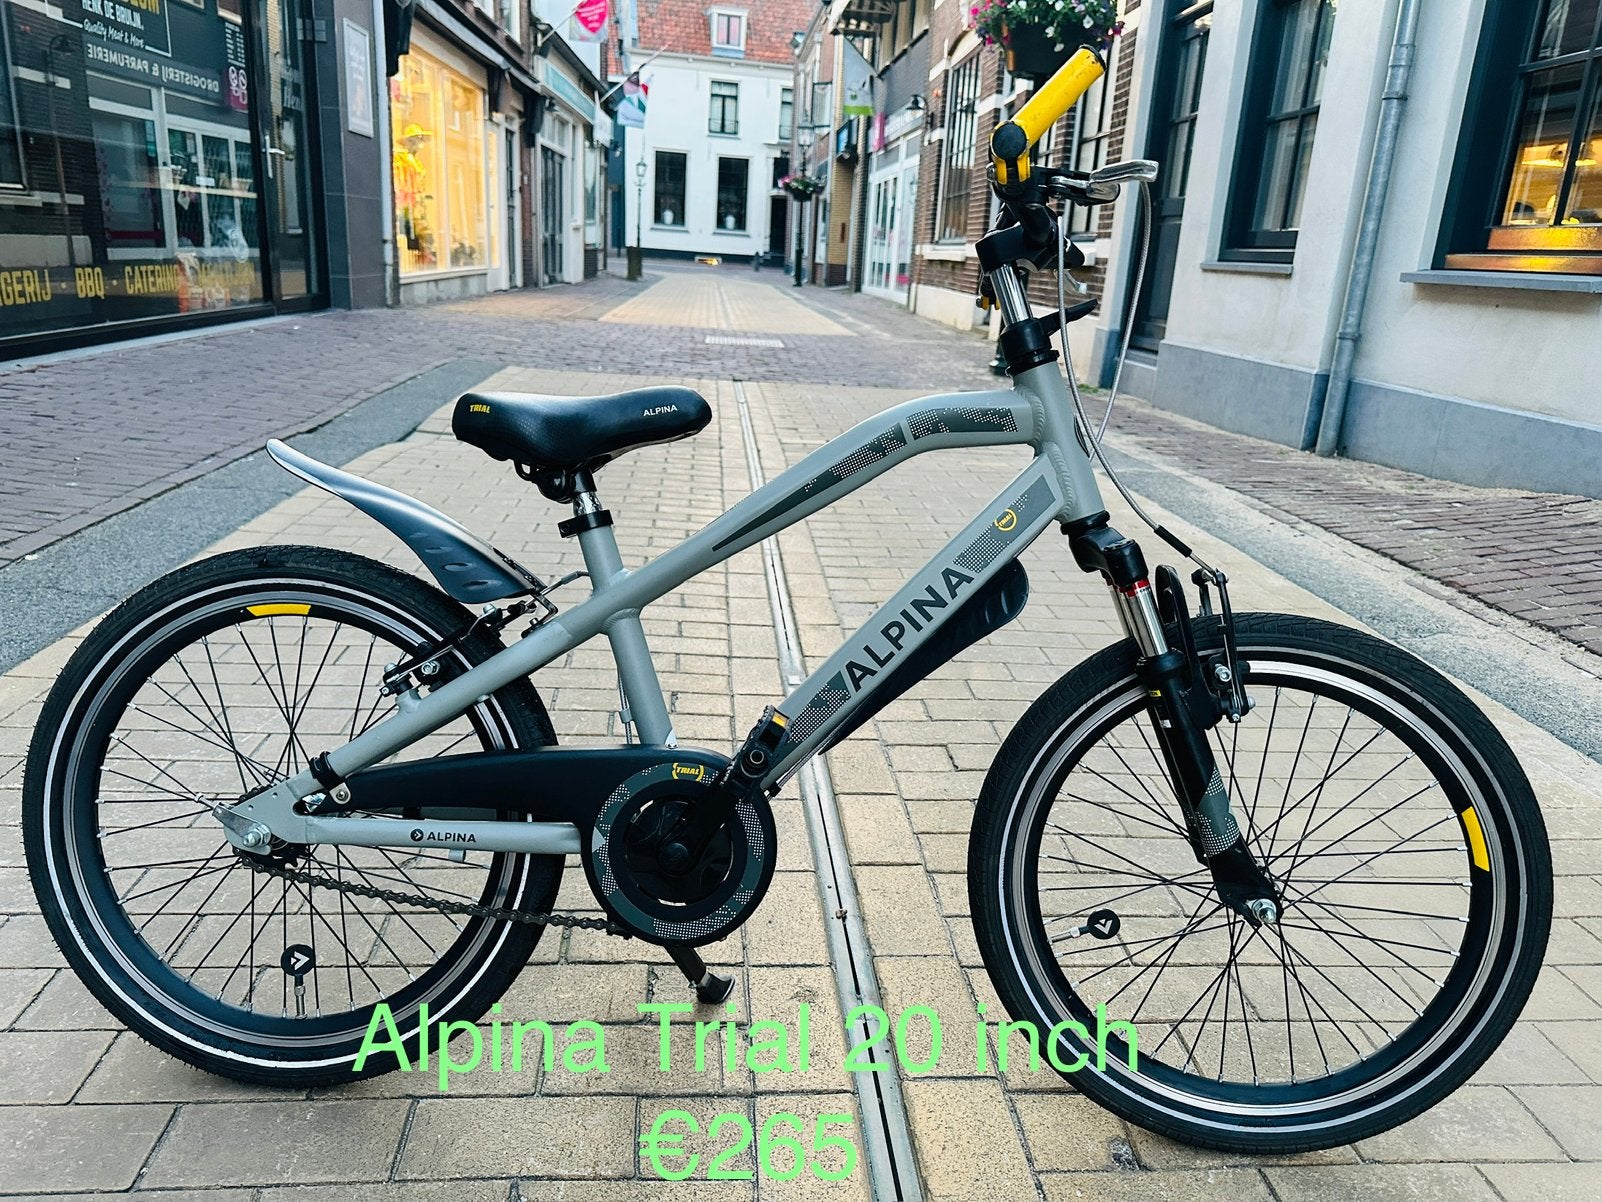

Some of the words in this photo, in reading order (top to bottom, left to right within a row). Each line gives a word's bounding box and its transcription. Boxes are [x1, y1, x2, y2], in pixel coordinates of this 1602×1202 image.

[103, 0, 115, 20] DE
[83, 18, 107, 42] Quality
[107, 25, 124, 41] Meat
[0, 269, 51, 307] GERIJ
[75, 267, 105, 300] BBQ
[470, 404, 490, 414] TRIAL
[643, 404, 678, 417] ALPINA
[845, 567, 975, 693] ALPINA
[427, 831, 477, 843] ALPINA
